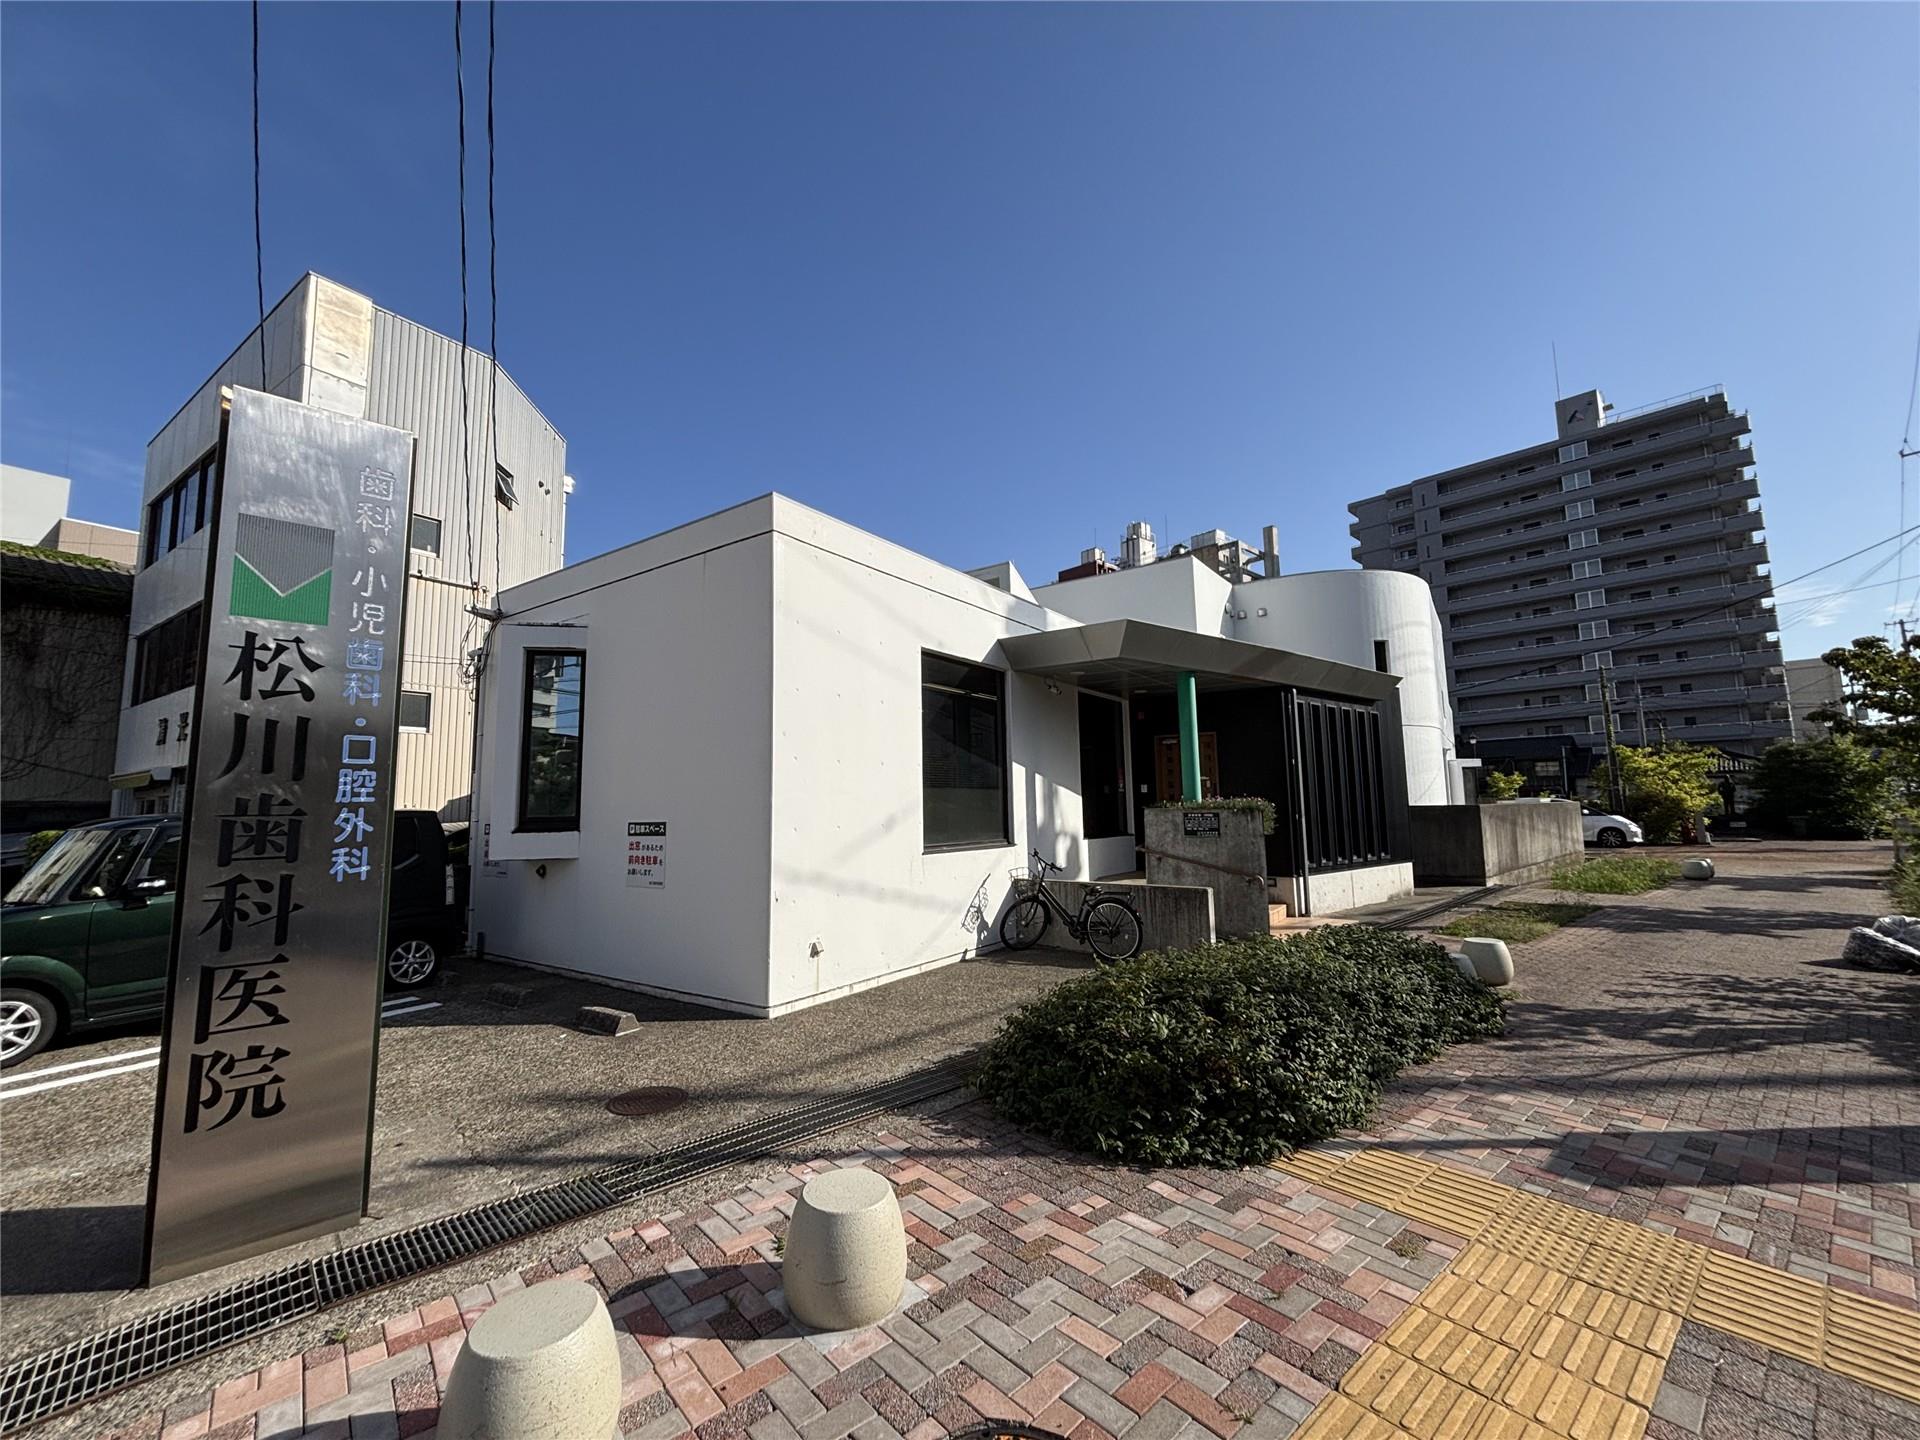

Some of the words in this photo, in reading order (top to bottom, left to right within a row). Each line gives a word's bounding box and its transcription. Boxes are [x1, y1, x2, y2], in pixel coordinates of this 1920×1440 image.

[184, 630, 325, 1134] 松川歯科医院
[329, 465, 395, 883] 歯科・小児歯科・口腔外科
